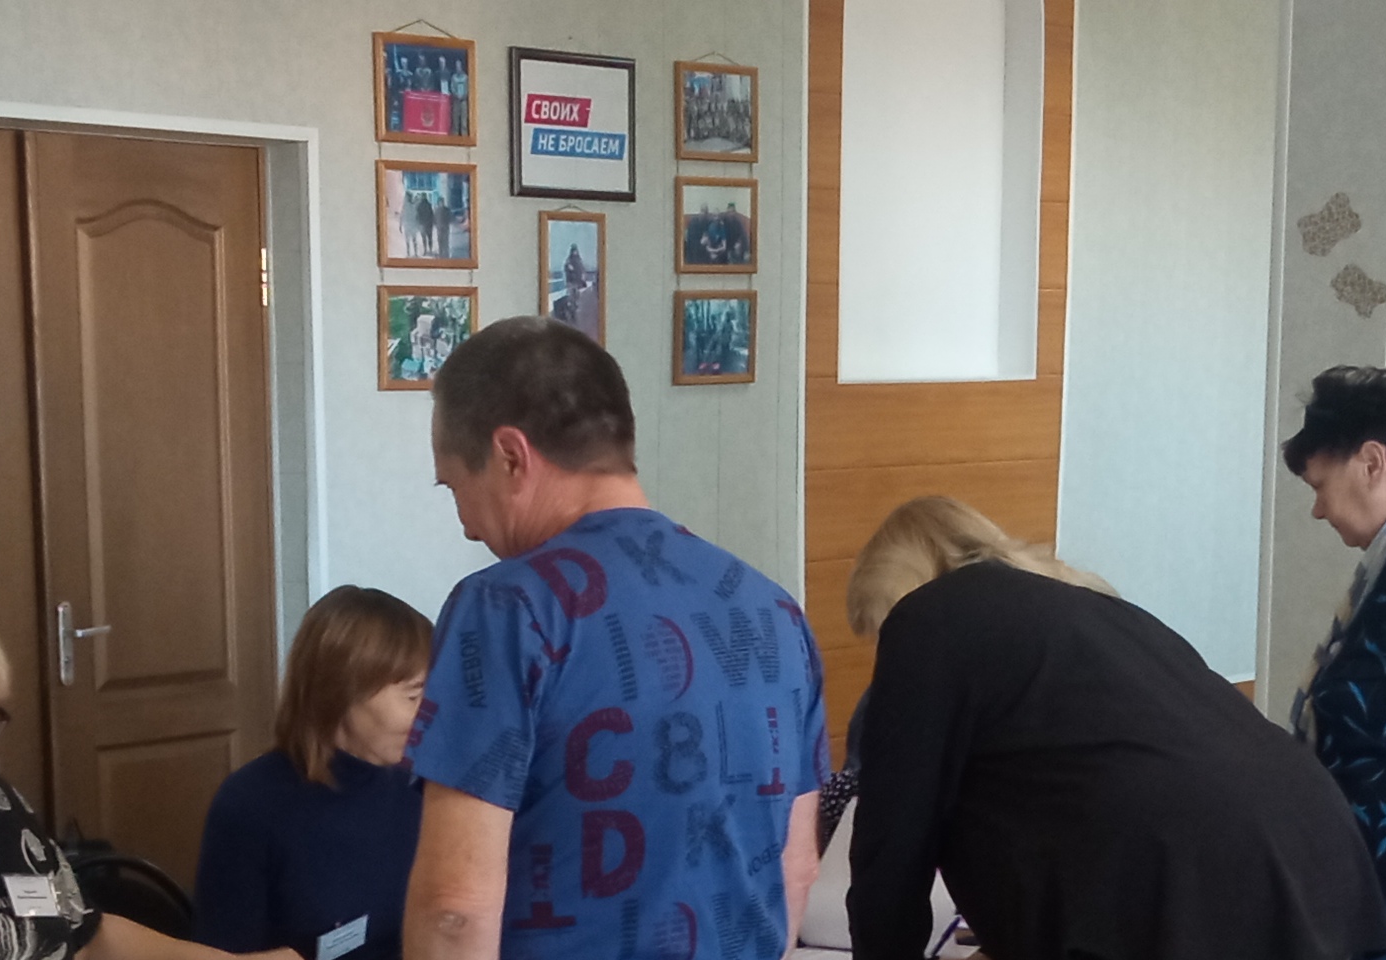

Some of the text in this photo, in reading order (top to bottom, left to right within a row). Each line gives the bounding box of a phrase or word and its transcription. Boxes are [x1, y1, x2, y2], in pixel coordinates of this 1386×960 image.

[531, 100, 580, 121] СВОИХ
[537, 134, 620, 155] НЕ БРОСАЕМ
